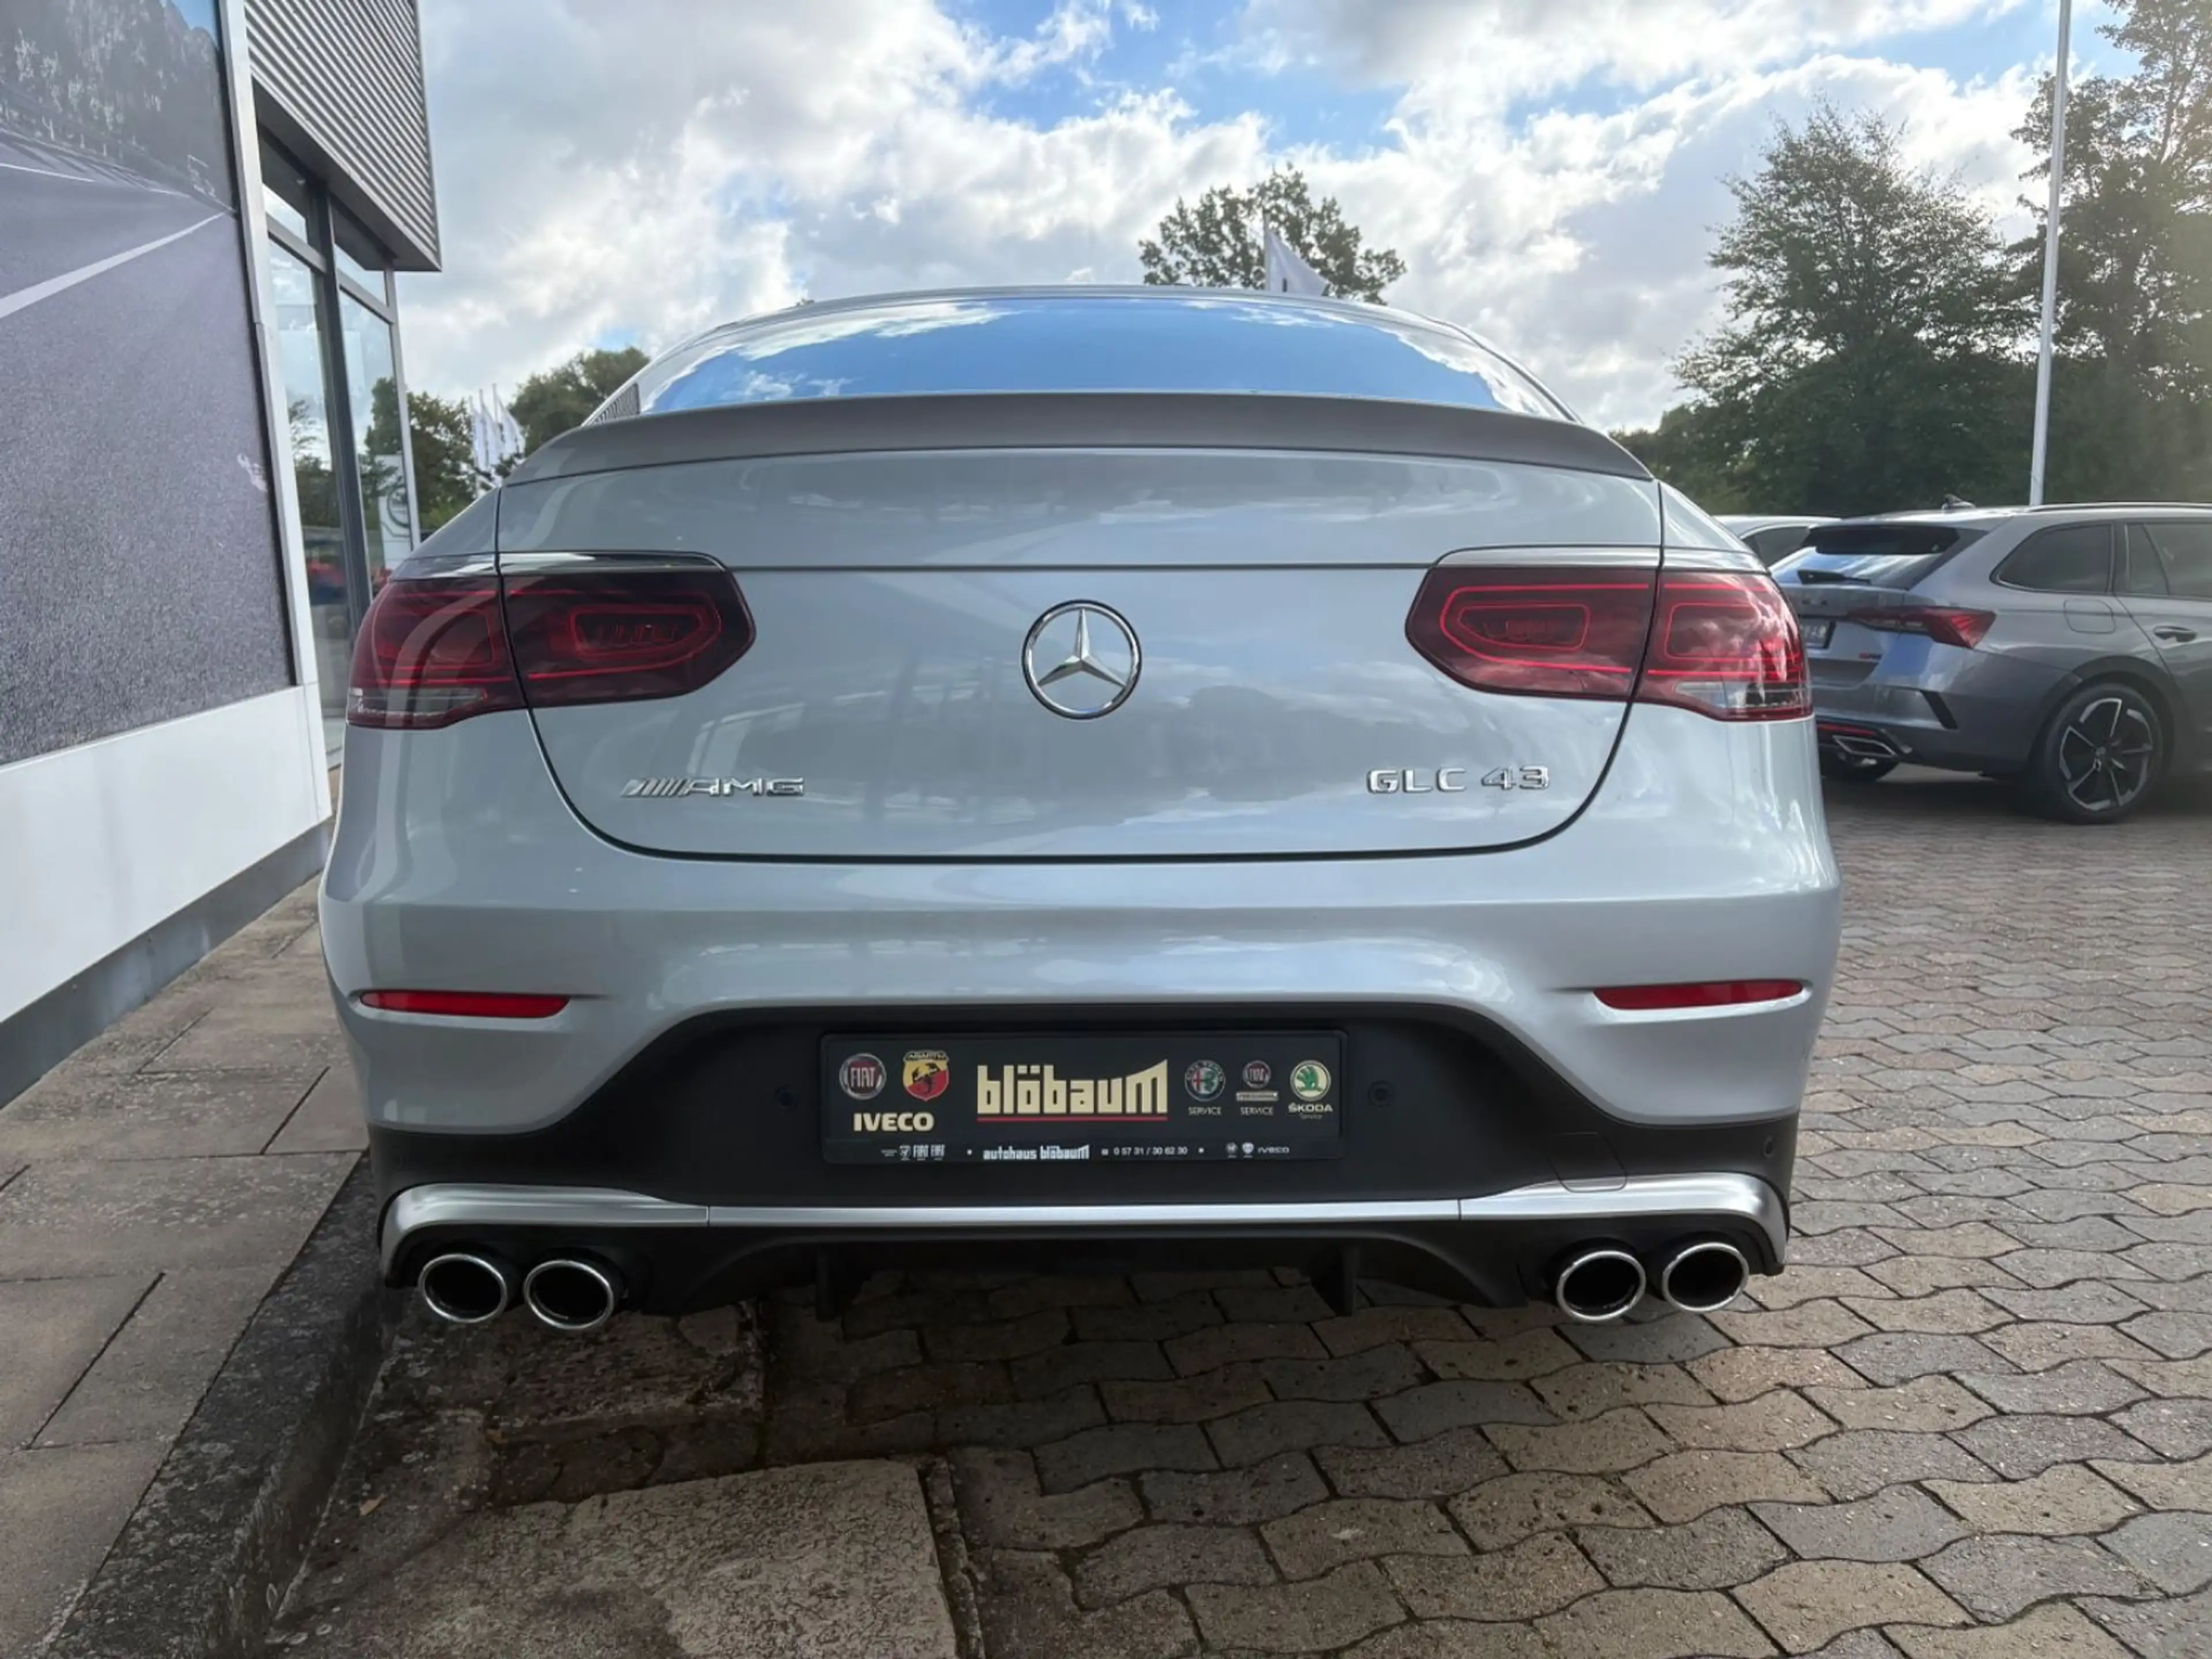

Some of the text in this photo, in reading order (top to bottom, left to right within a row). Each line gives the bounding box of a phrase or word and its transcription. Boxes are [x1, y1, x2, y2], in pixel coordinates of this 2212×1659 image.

[690, 778, 804, 796] AMG
[1366, 766, 1550, 793] GLC 43
[850, 1067, 876, 1088] FIAT
[1188, 1107, 1222, 1116] SERVICE
[1240, 1107, 1274, 1116] SERVICE
[1288, 1102, 1334, 1112] ŠKODA
[853, 1112, 934, 1132] IVECO
[983, 1146, 1037, 1160] autohaus
